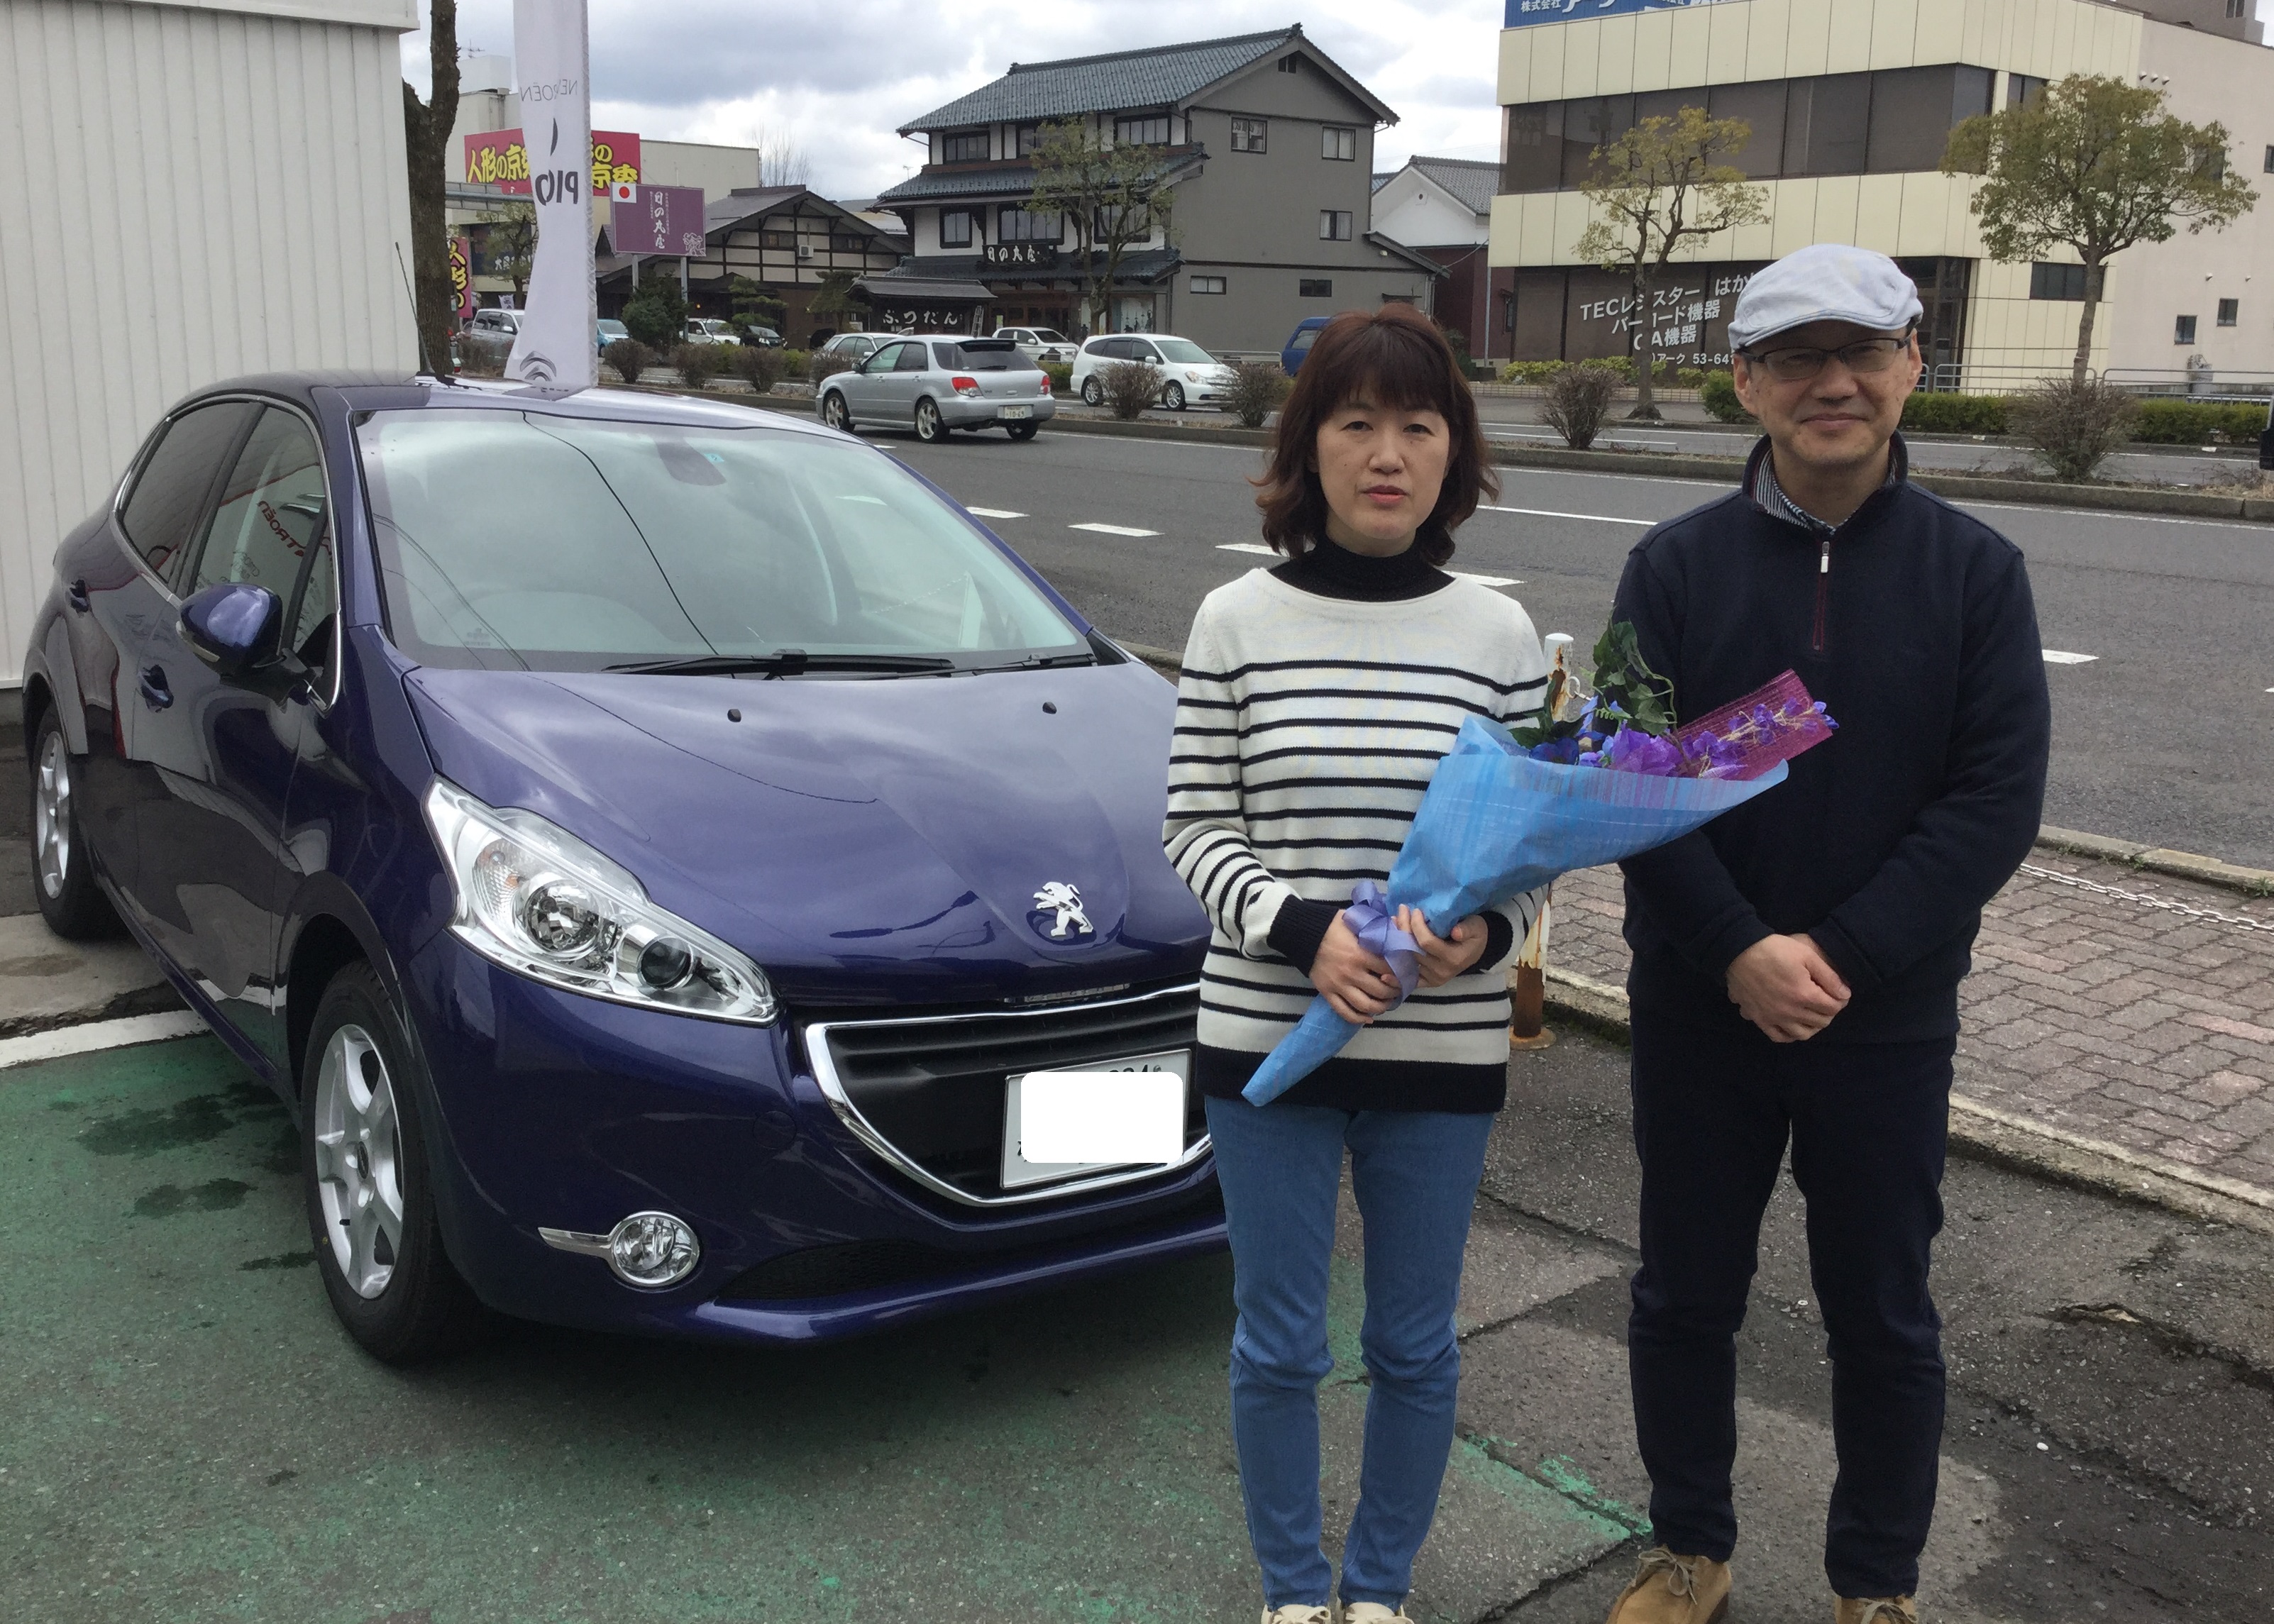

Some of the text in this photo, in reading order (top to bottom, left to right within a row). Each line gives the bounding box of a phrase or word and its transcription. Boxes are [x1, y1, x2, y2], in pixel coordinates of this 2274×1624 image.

[1520, 0, 1561, 13] 株式会社
[1715, 272, 1754, 296] はか
[883, 309, 958, 325] ぶつだん
